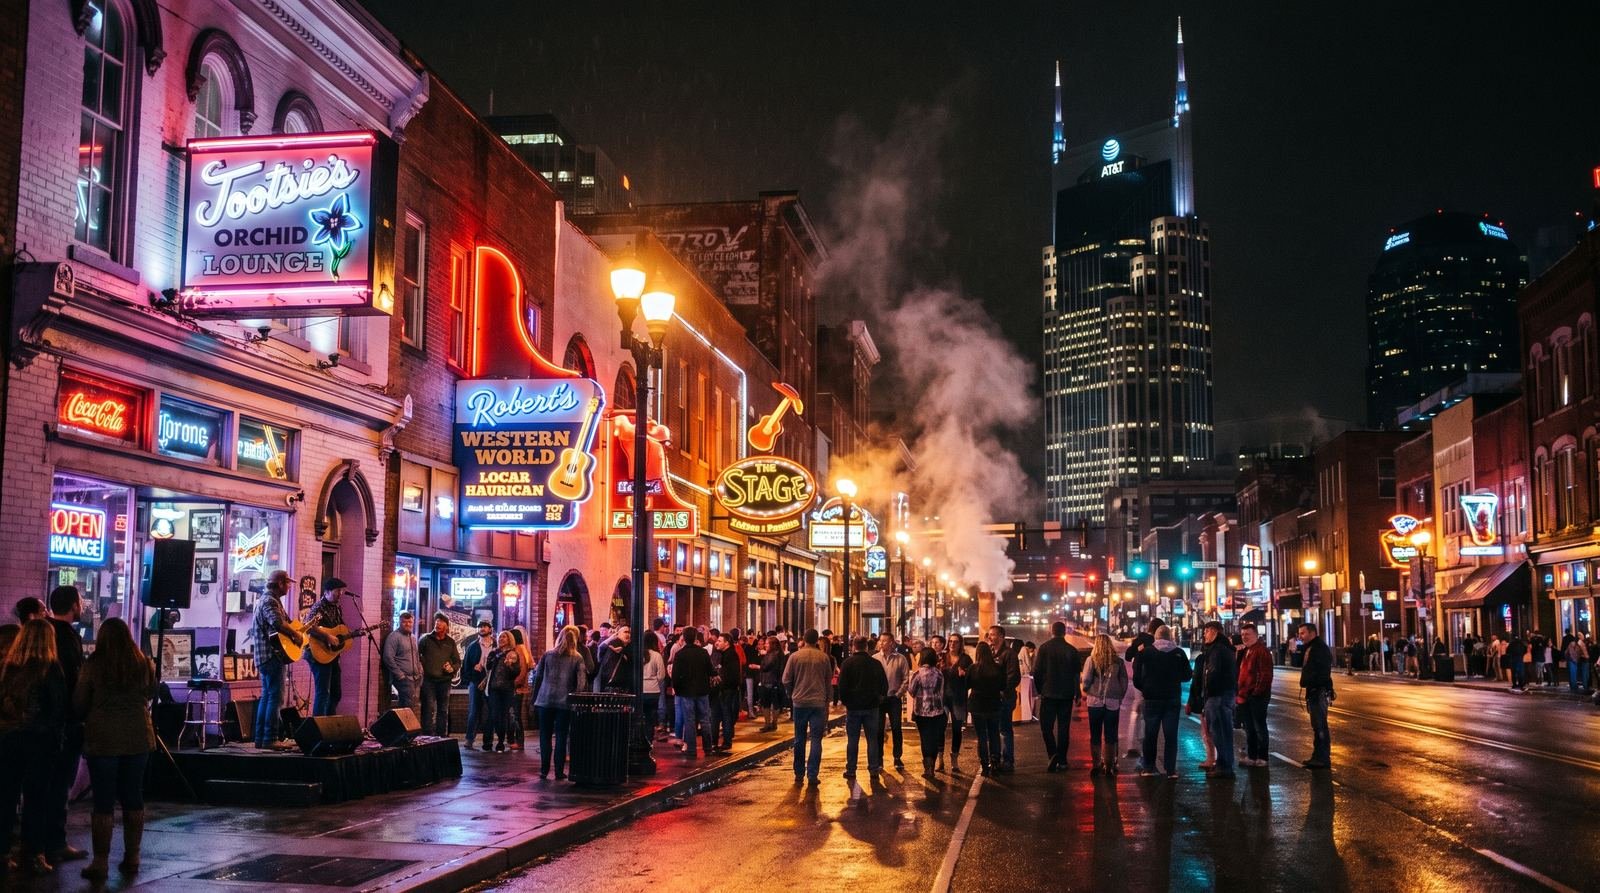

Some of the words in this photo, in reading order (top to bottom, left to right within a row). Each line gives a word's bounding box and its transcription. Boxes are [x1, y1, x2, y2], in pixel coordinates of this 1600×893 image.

[1101, 161, 1124, 178] AT&T
[195, 154, 360, 228] Tootsie's
[213, 227, 309, 248] ORCHID
[202, 250, 325, 277] LOUNGE
[67, 392, 126, 432] Coca-Cola
[467, 383, 579, 427] Robert's
[460, 430, 571, 447] WESTERN
[474, 449, 556, 465] WORLD
[479, 471, 531, 484] LOCAR
[754, 463, 777, 473] THE
[465, 484, 545, 497] HAURICAN
[722, 468, 809, 508] STAGE
[53, 509, 102, 539] OPEN
